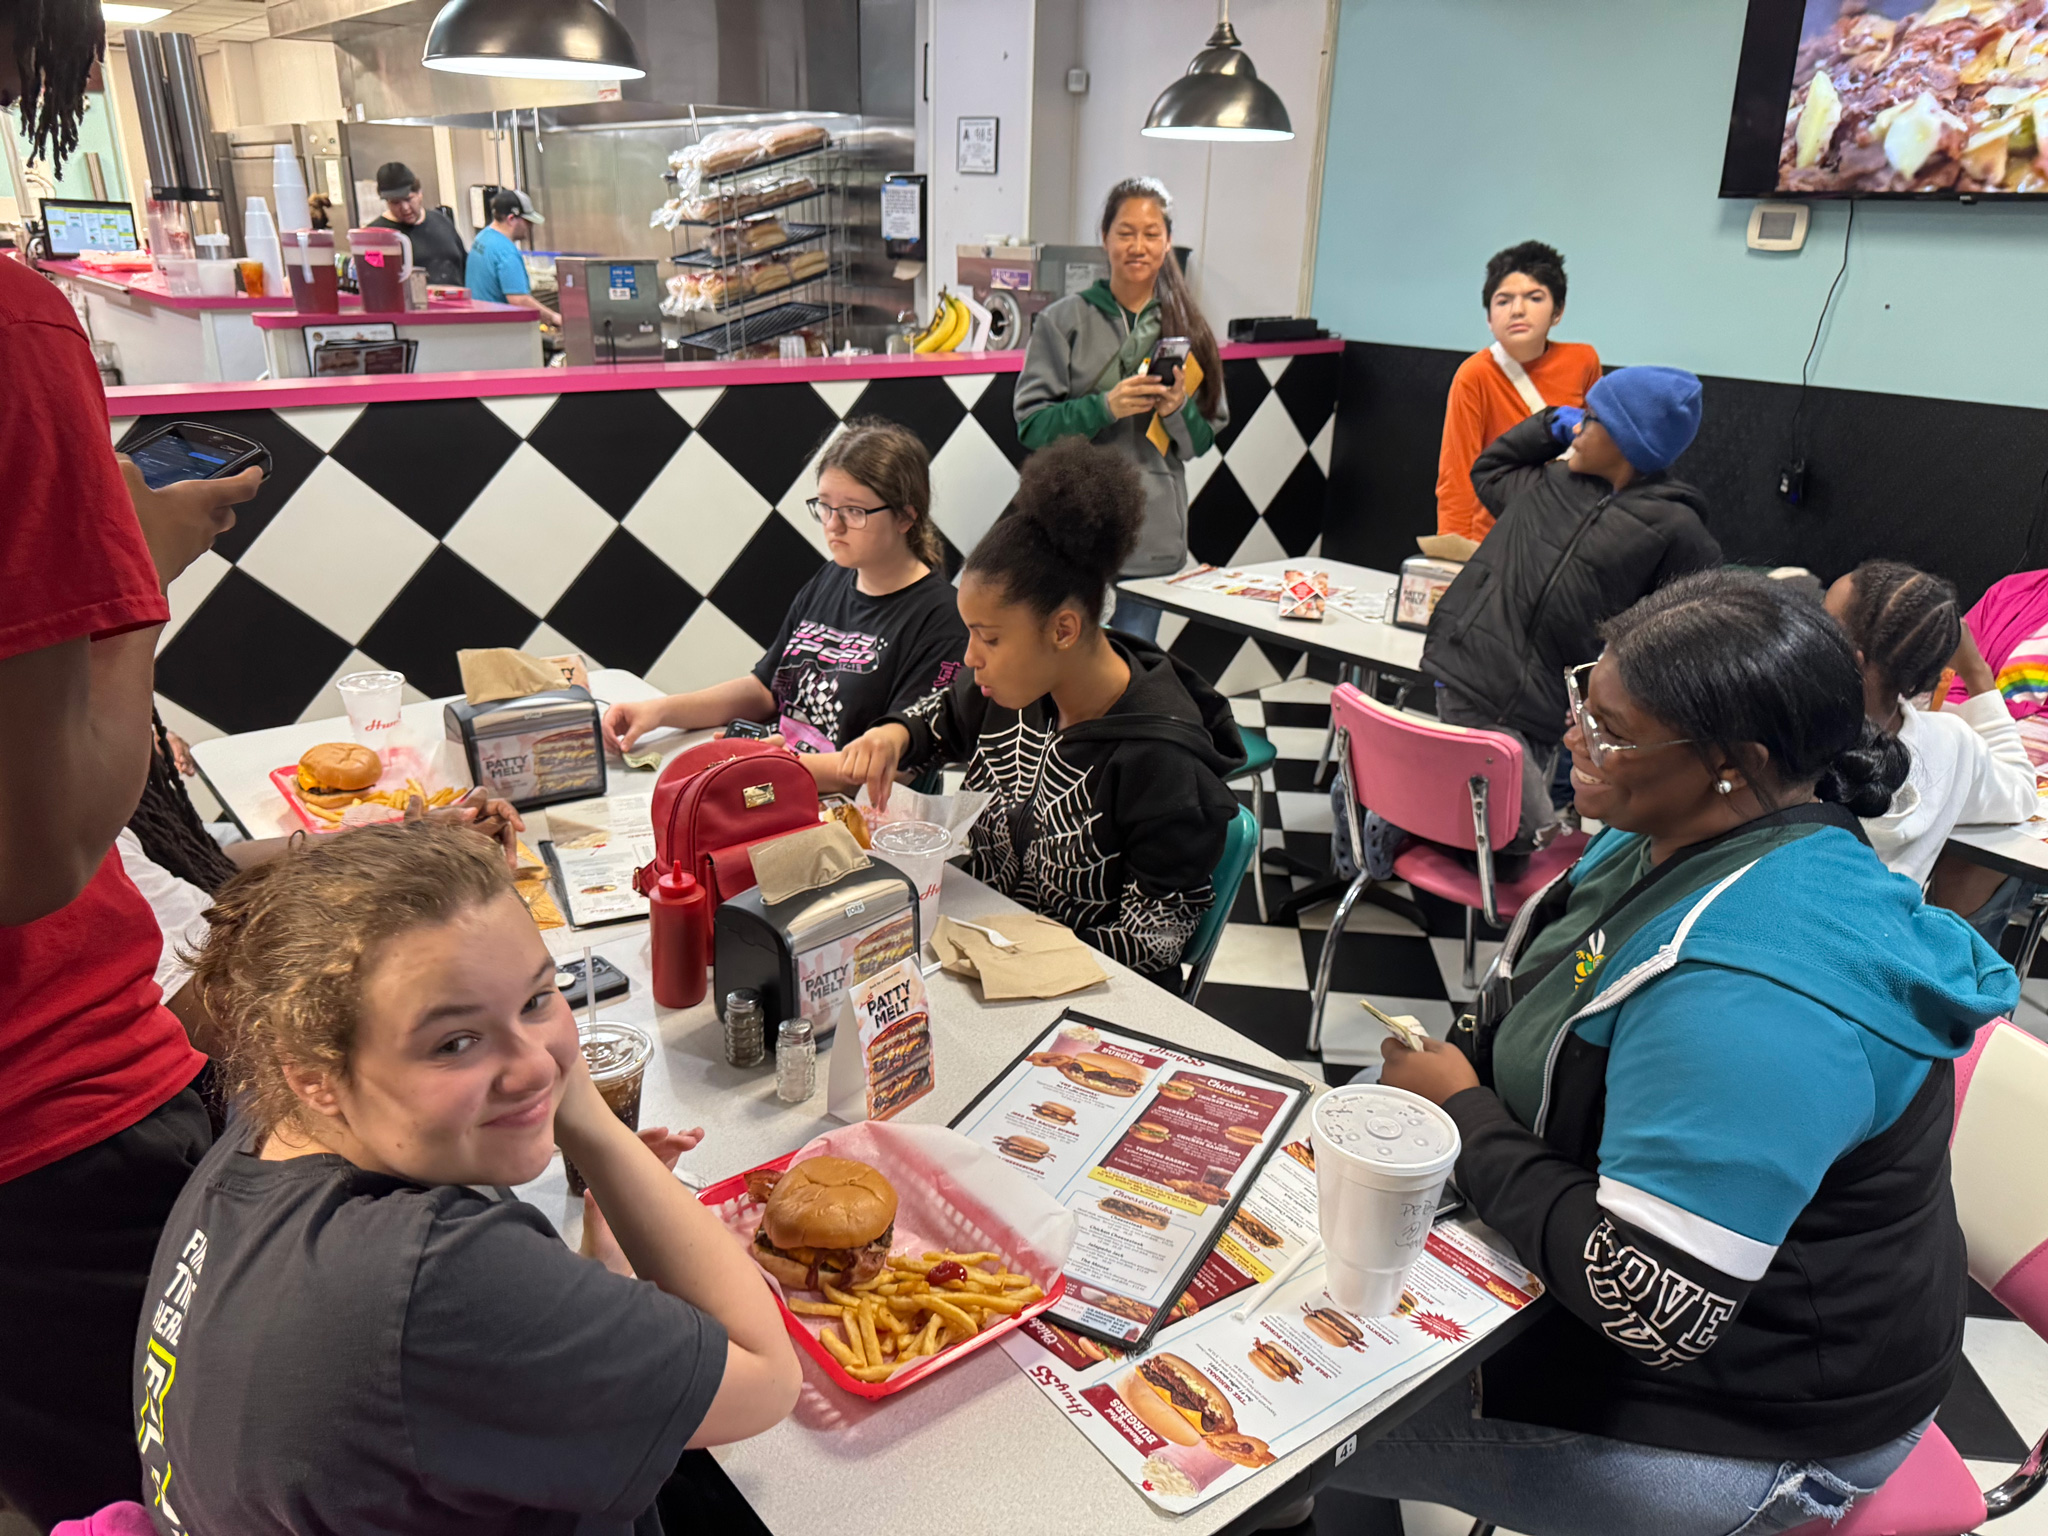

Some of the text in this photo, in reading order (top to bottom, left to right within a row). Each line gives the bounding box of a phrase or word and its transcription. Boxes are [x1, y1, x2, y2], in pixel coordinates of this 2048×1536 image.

[486, 754, 528, 771] PATTY
[491, 765, 525, 778] MELT
[846, 903, 864, 916] TORK
[805, 963, 849, 992] PATTY
[810, 977, 845, 1002] MELT
[867, 979, 910, 1016] PATTY
[875, 996, 909, 1028] MELT
[1101, 1047, 1145, 1065] BURGERS
[1206, 1078, 1247, 1098] Chicken
[1135, 1145, 1191, 1167] TENDERS BASKET
[1111, 1188, 1175, 1215] Cheesesteaks
[1088, 1224, 1110, 1235] Chicken
[1463, 1245, 1495, 1266] SIGNATURE
[1451, 1262, 1470, 1277] SIDES
[1414, 1290, 1435, 1305] BUILD
[1259, 1318, 1283, 1340] BURGER
[1029, 1365, 1092, 1418] Hwy55
[1105, 1408, 1143, 1446] Handcrafted
[1110, 1398, 1158, 1444] BURGERS
